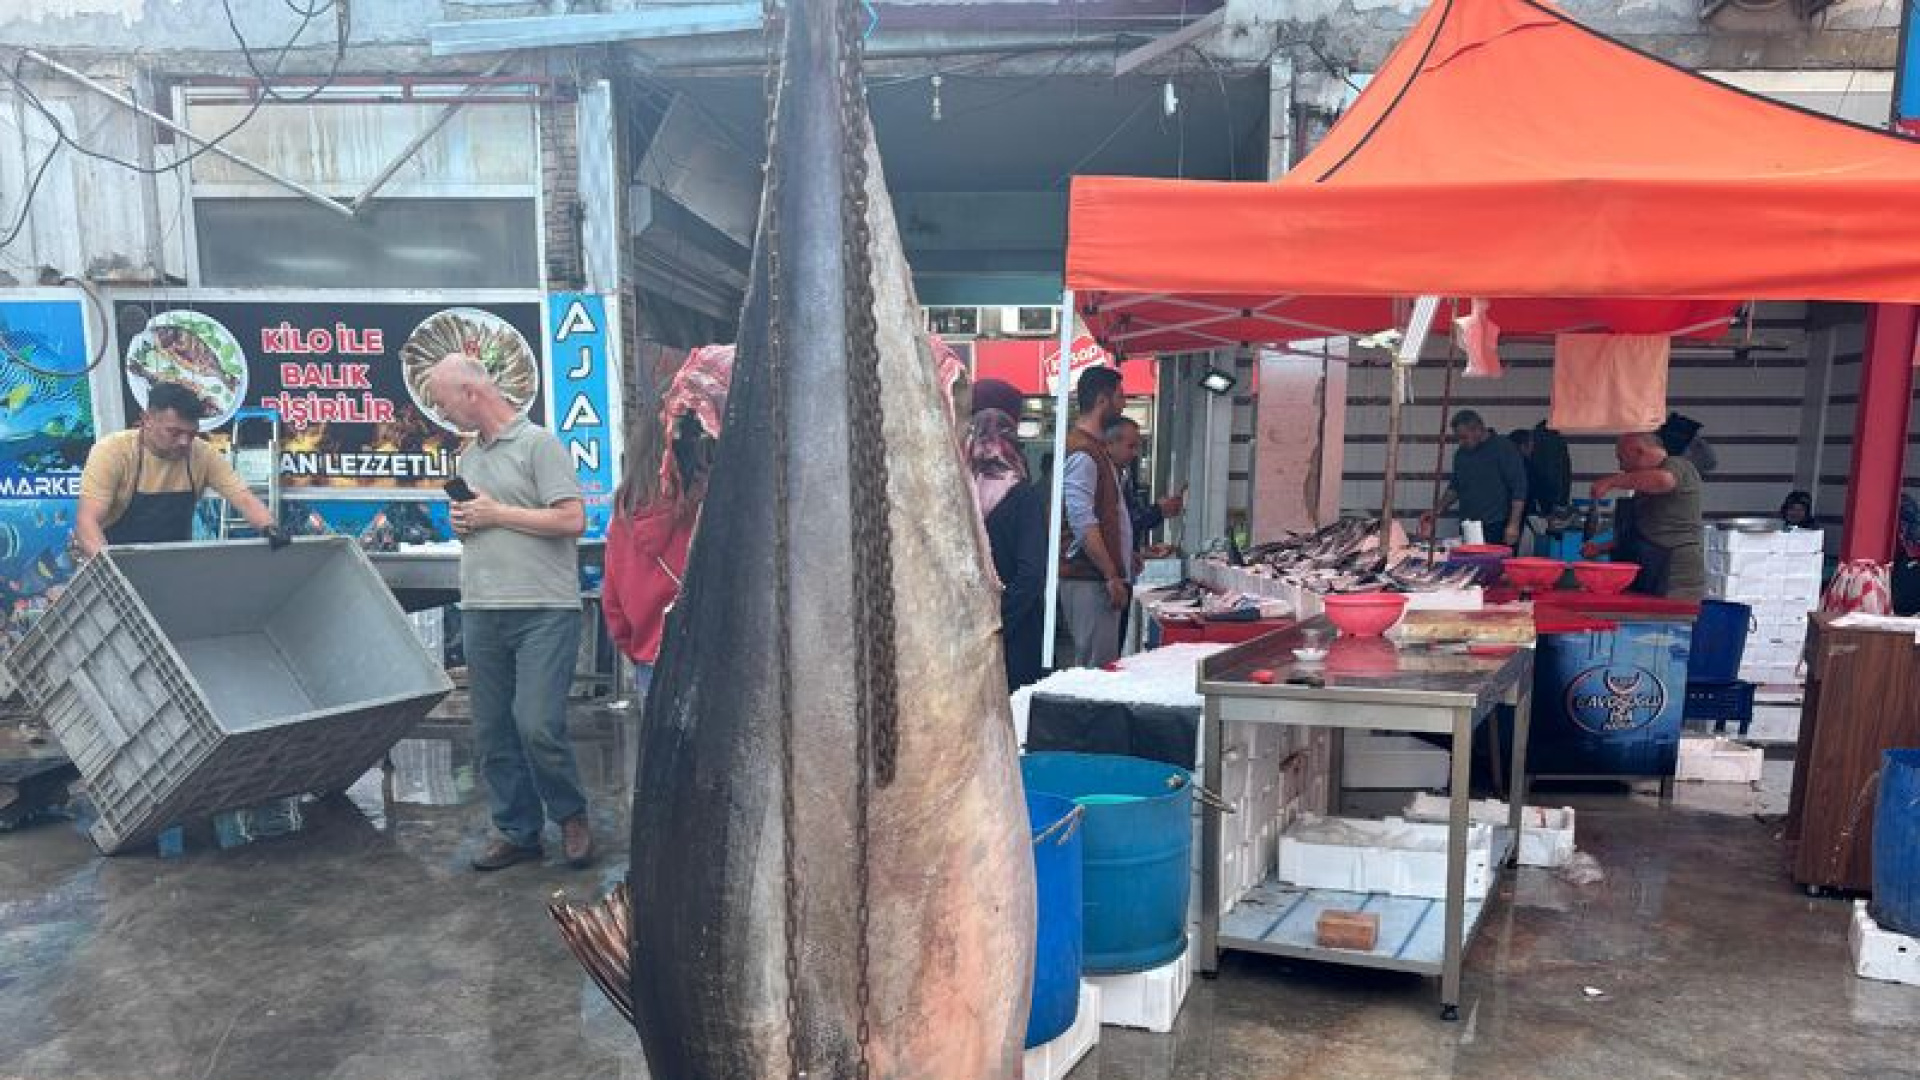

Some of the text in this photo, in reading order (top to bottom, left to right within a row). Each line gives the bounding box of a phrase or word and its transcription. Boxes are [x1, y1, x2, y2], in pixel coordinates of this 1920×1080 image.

[261, 321, 384, 353] KİLO İLE
[280, 362, 372, 389] BALIK
[326, 449, 447, 476] LEZZETLİ
